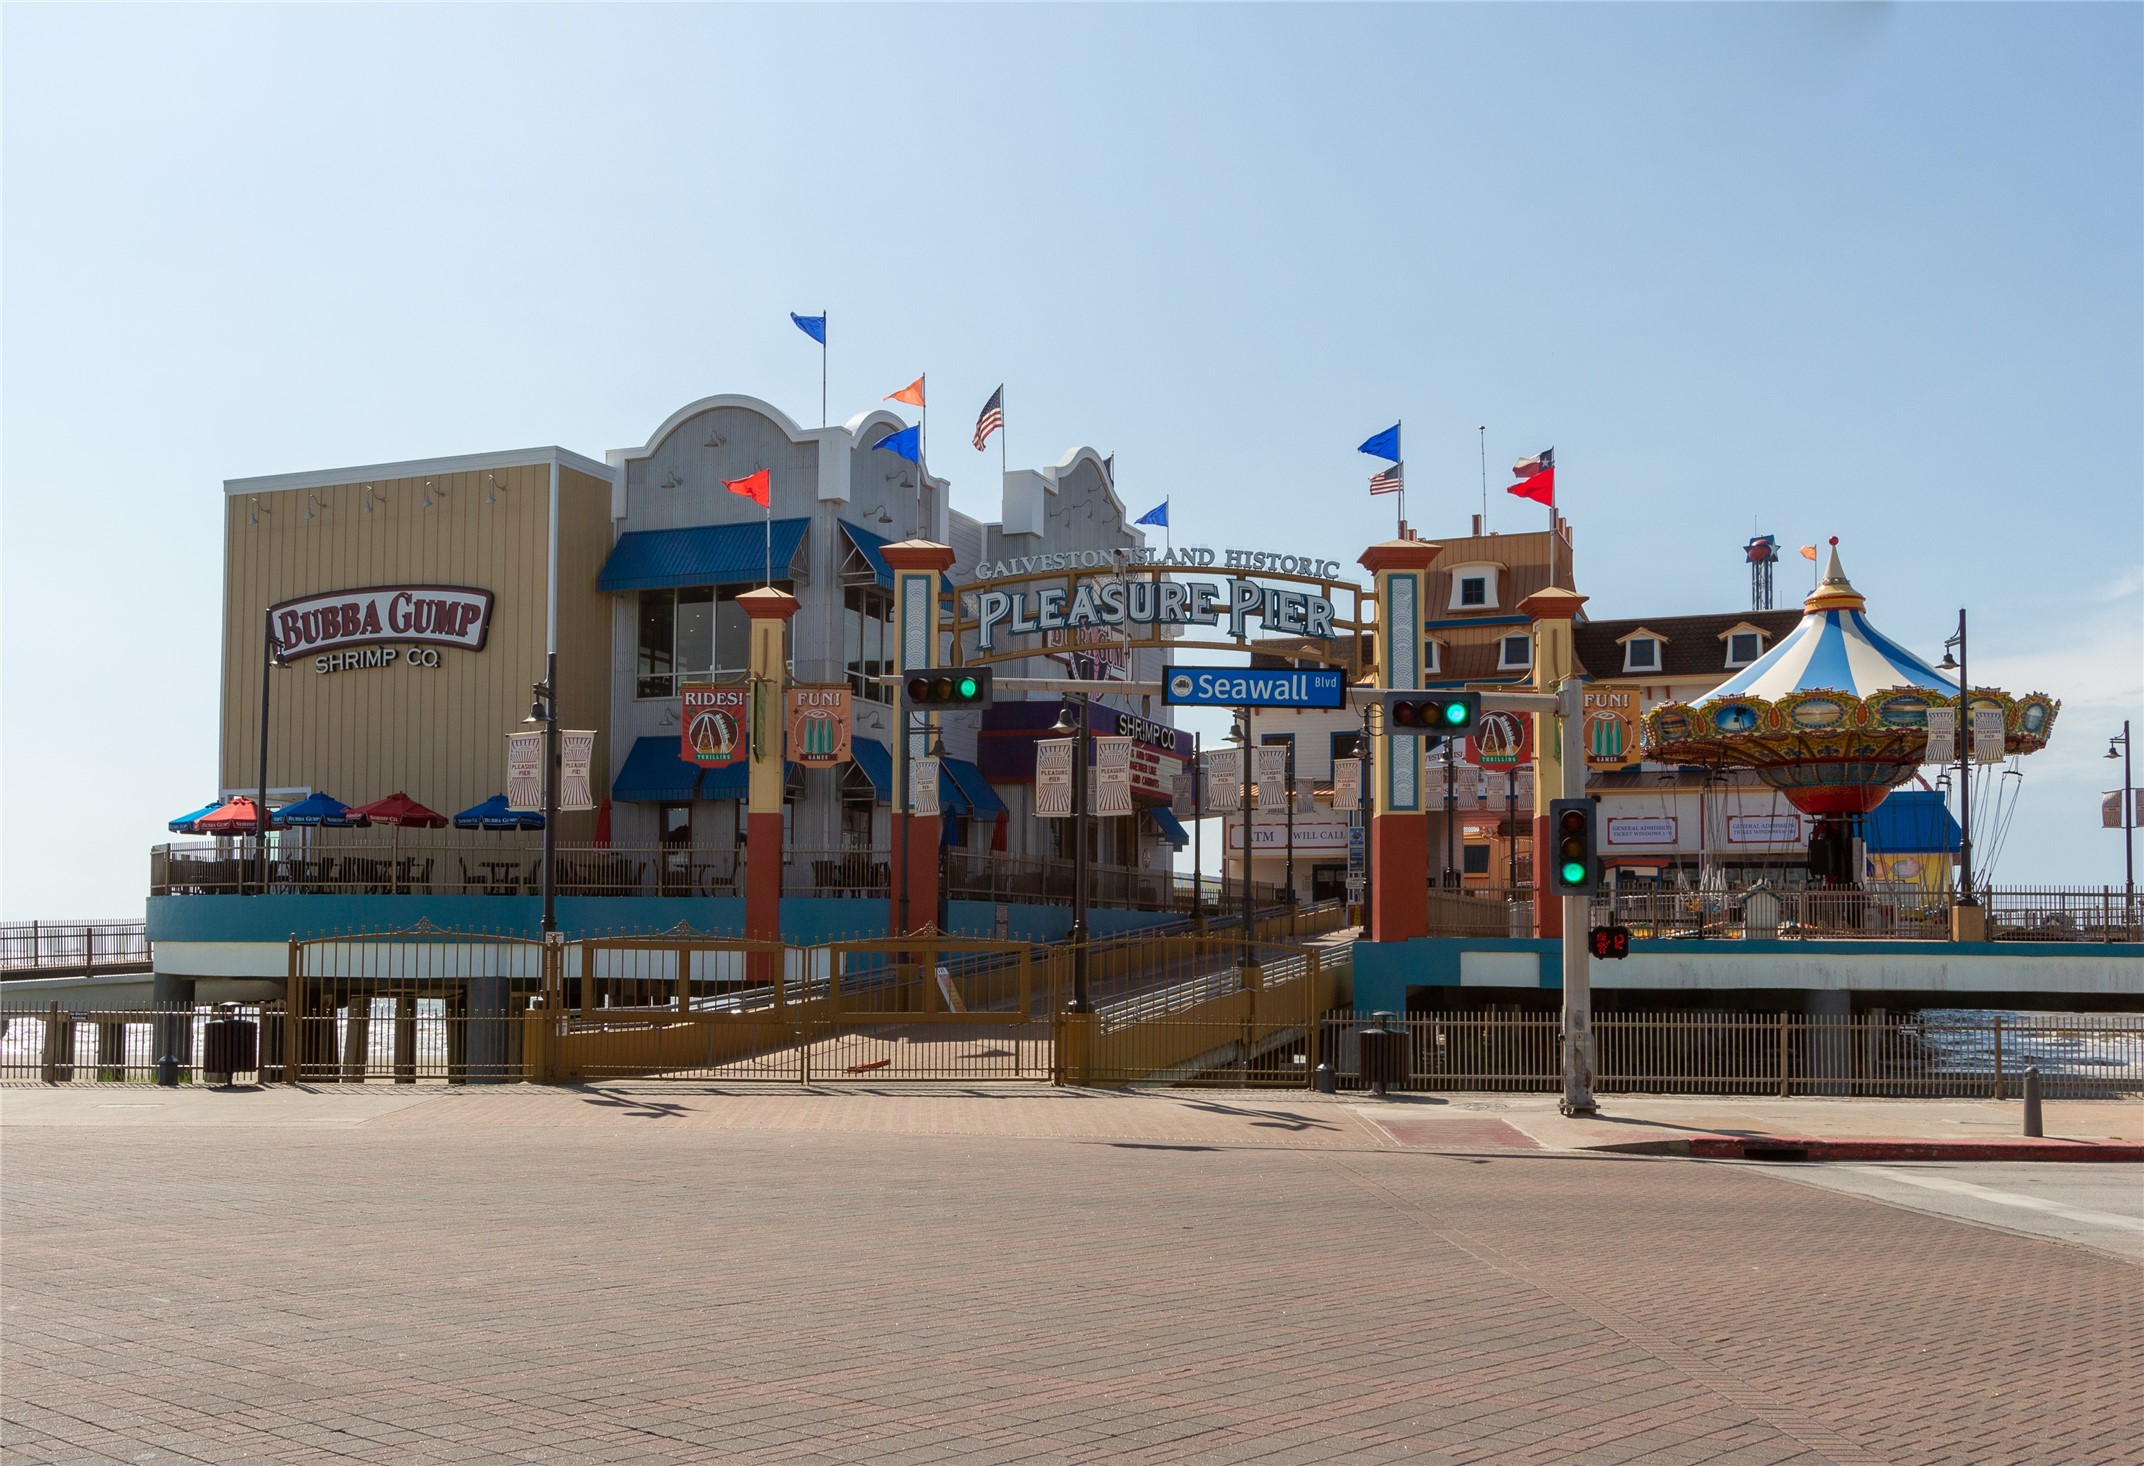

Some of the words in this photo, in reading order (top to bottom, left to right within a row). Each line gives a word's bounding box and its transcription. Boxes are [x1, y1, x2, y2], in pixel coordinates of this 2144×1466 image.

[975, 549, 1115, 581] GALVESTON
[1129, 547, 1216, 567] ISLAND
[1225, 549, 1341, 580] HISTORIC
[278, 599, 383, 651] BUBBA
[388, 592, 482, 638] GUMP
[976, 581, 1220, 650] PLEASURE
[1226, 578, 1339, 643] PIER
[315, 648, 398, 674] SHRIMP
[1198, 674, 1308, 700] Seawall
[1314, 676, 1337, 688] Blvd
[685, 692, 743, 706] RIDES!
[797, 692, 841, 706] FUN!
[1584, 693, 1629, 708] FUN!
[1119, 714, 1160, 745] SHRIMP
[697, 753, 731, 761] THRILLING
[306, 814, 320, 822] GUMP
[1251, 831, 1274, 841] TM
[1293, 831, 1317, 840] WILL
[1320, 831, 1345, 839] CALL
[1614, 934, 1625, 950] 12
